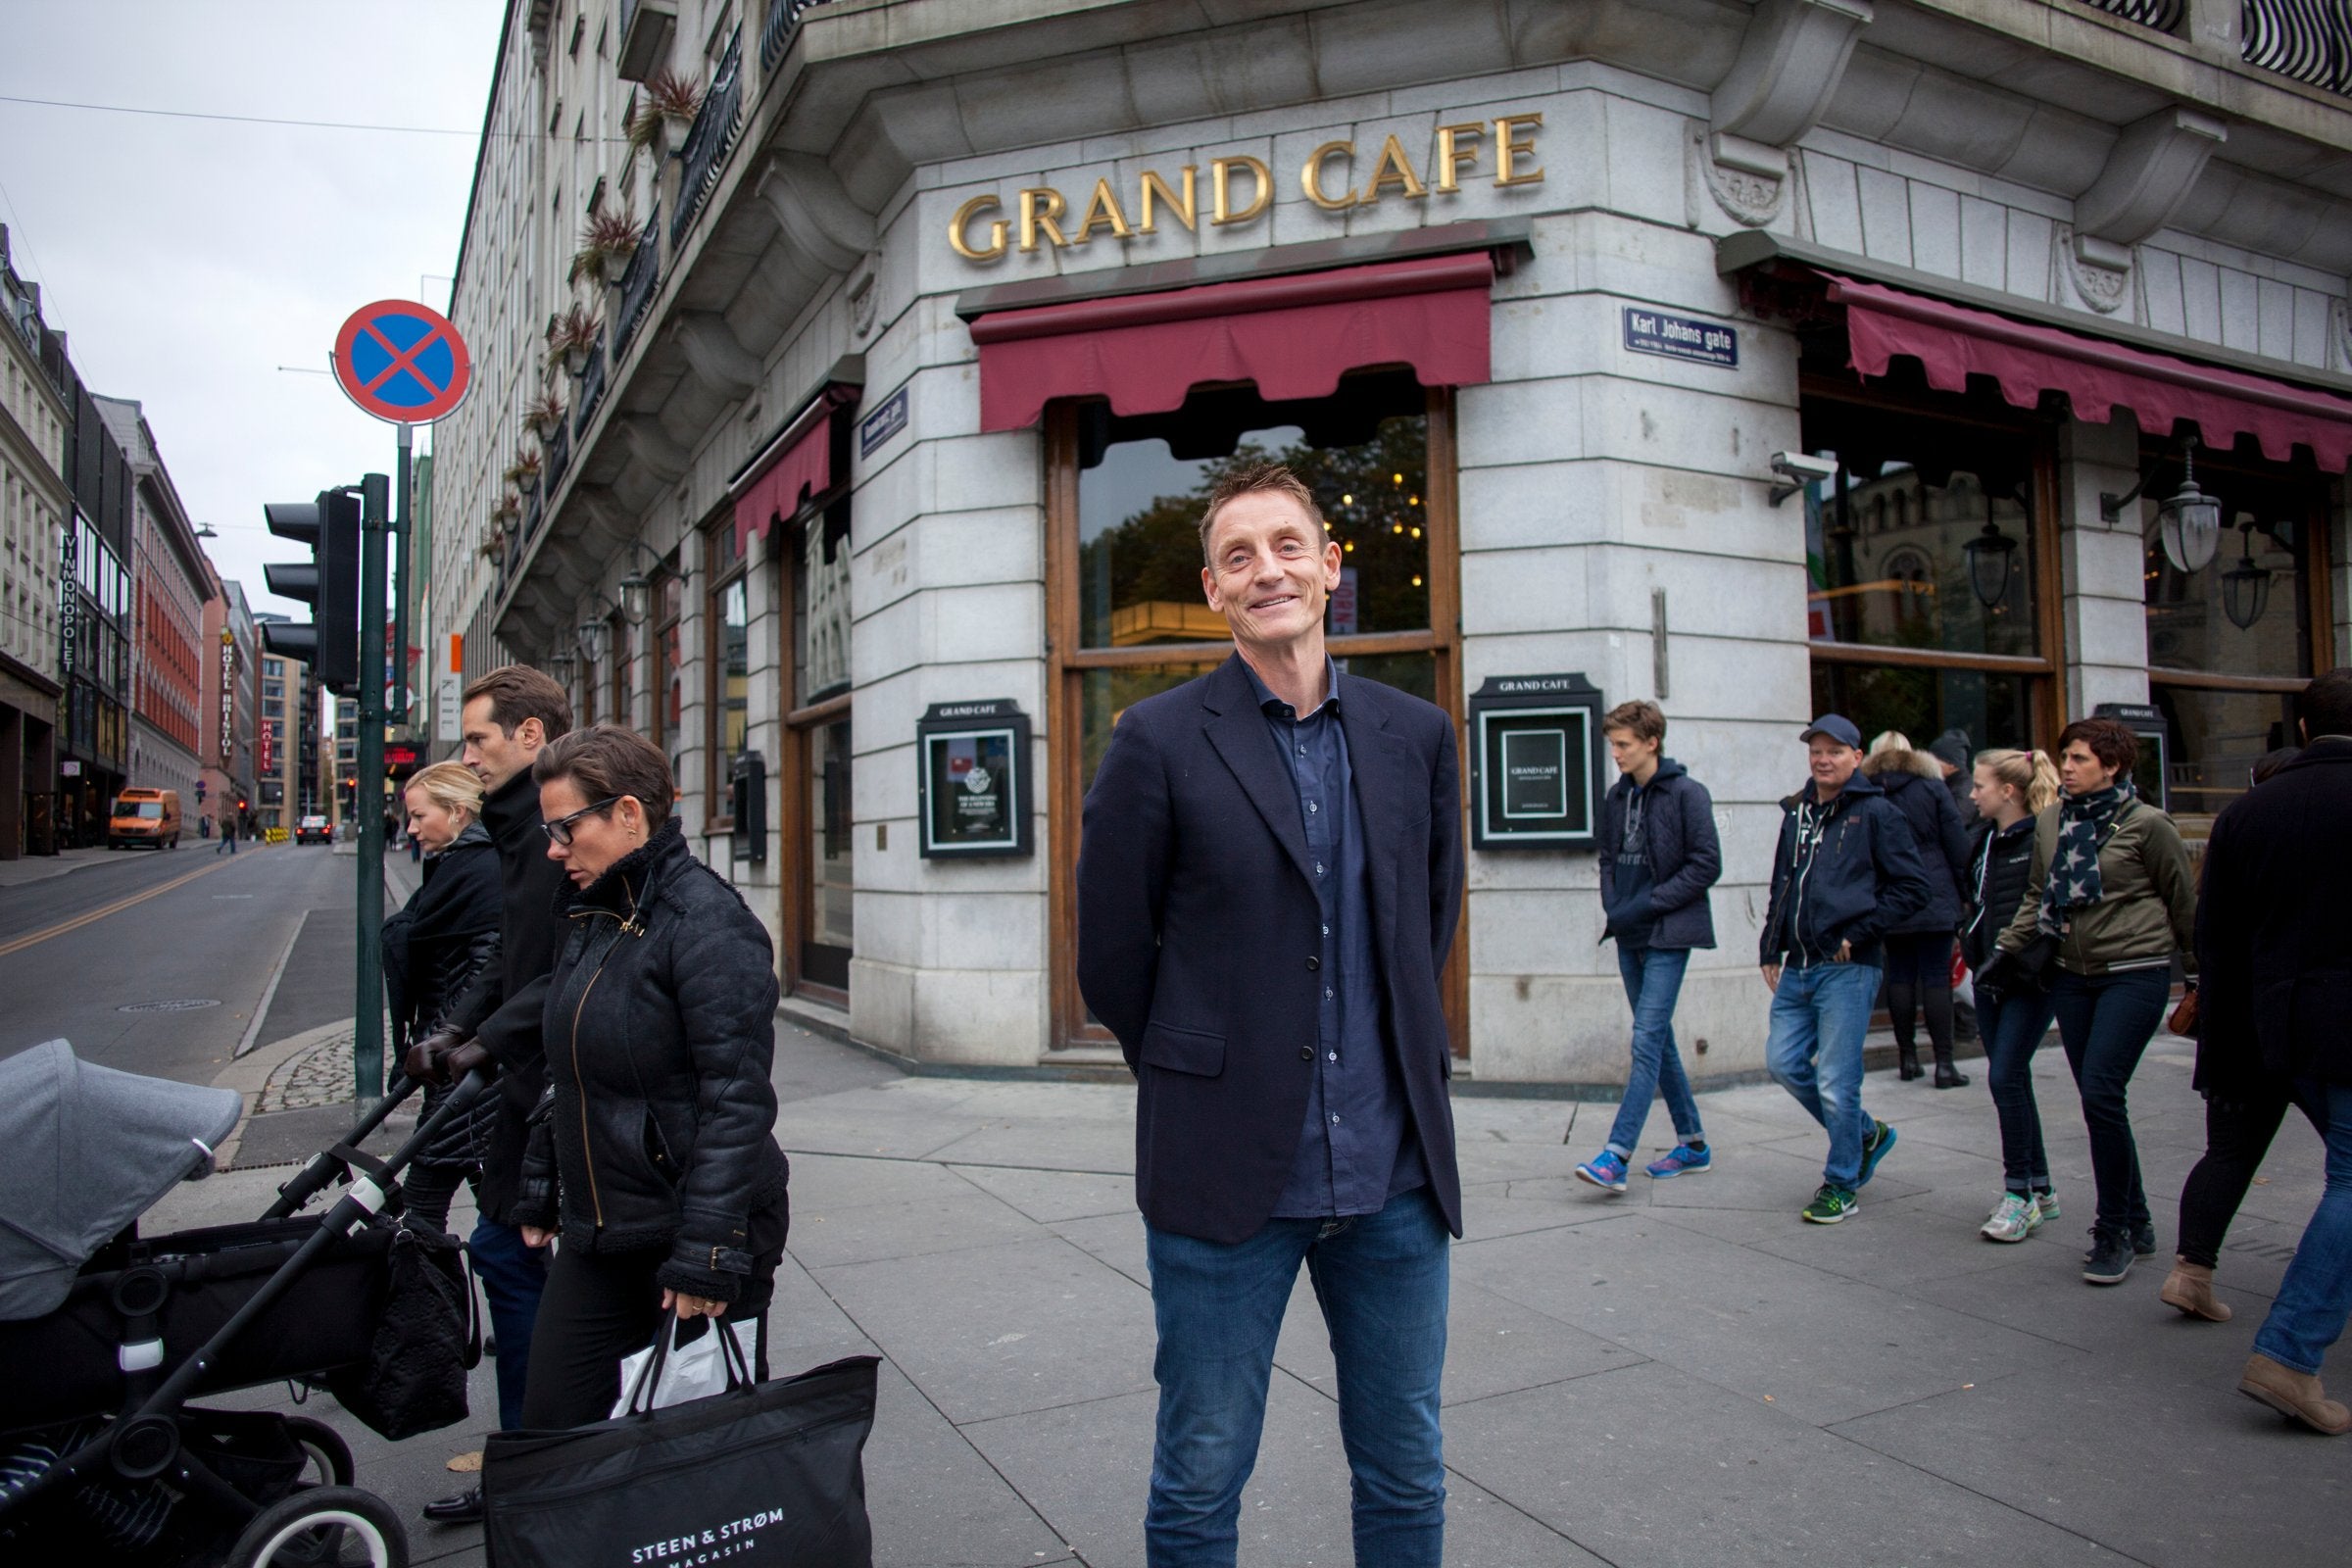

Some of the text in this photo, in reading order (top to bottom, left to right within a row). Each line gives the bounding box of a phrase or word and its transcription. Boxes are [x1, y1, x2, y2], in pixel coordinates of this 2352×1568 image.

[948, 112, 1545, 261] GRAND CAFE
[1631, 313, 1657, 335] Karl
[1661, 318, 1702, 345] Johans
[1705, 329, 1732, 351] gate
[63, 536, 76, 672] VINMONOPOLET
[222, 645, 233, 690] HOTEL
[1499, 678, 1571, 692] GRAND CAFE
[939, 705, 996, 716] GRAND CAFE
[263, 722, 272, 769] HOTEL
[1511, 766, 1539, 775] GRAND
[632, 1507, 783, 1564] STEEN & STRØM
[668, 1539, 755, 1568] MAGASIN
